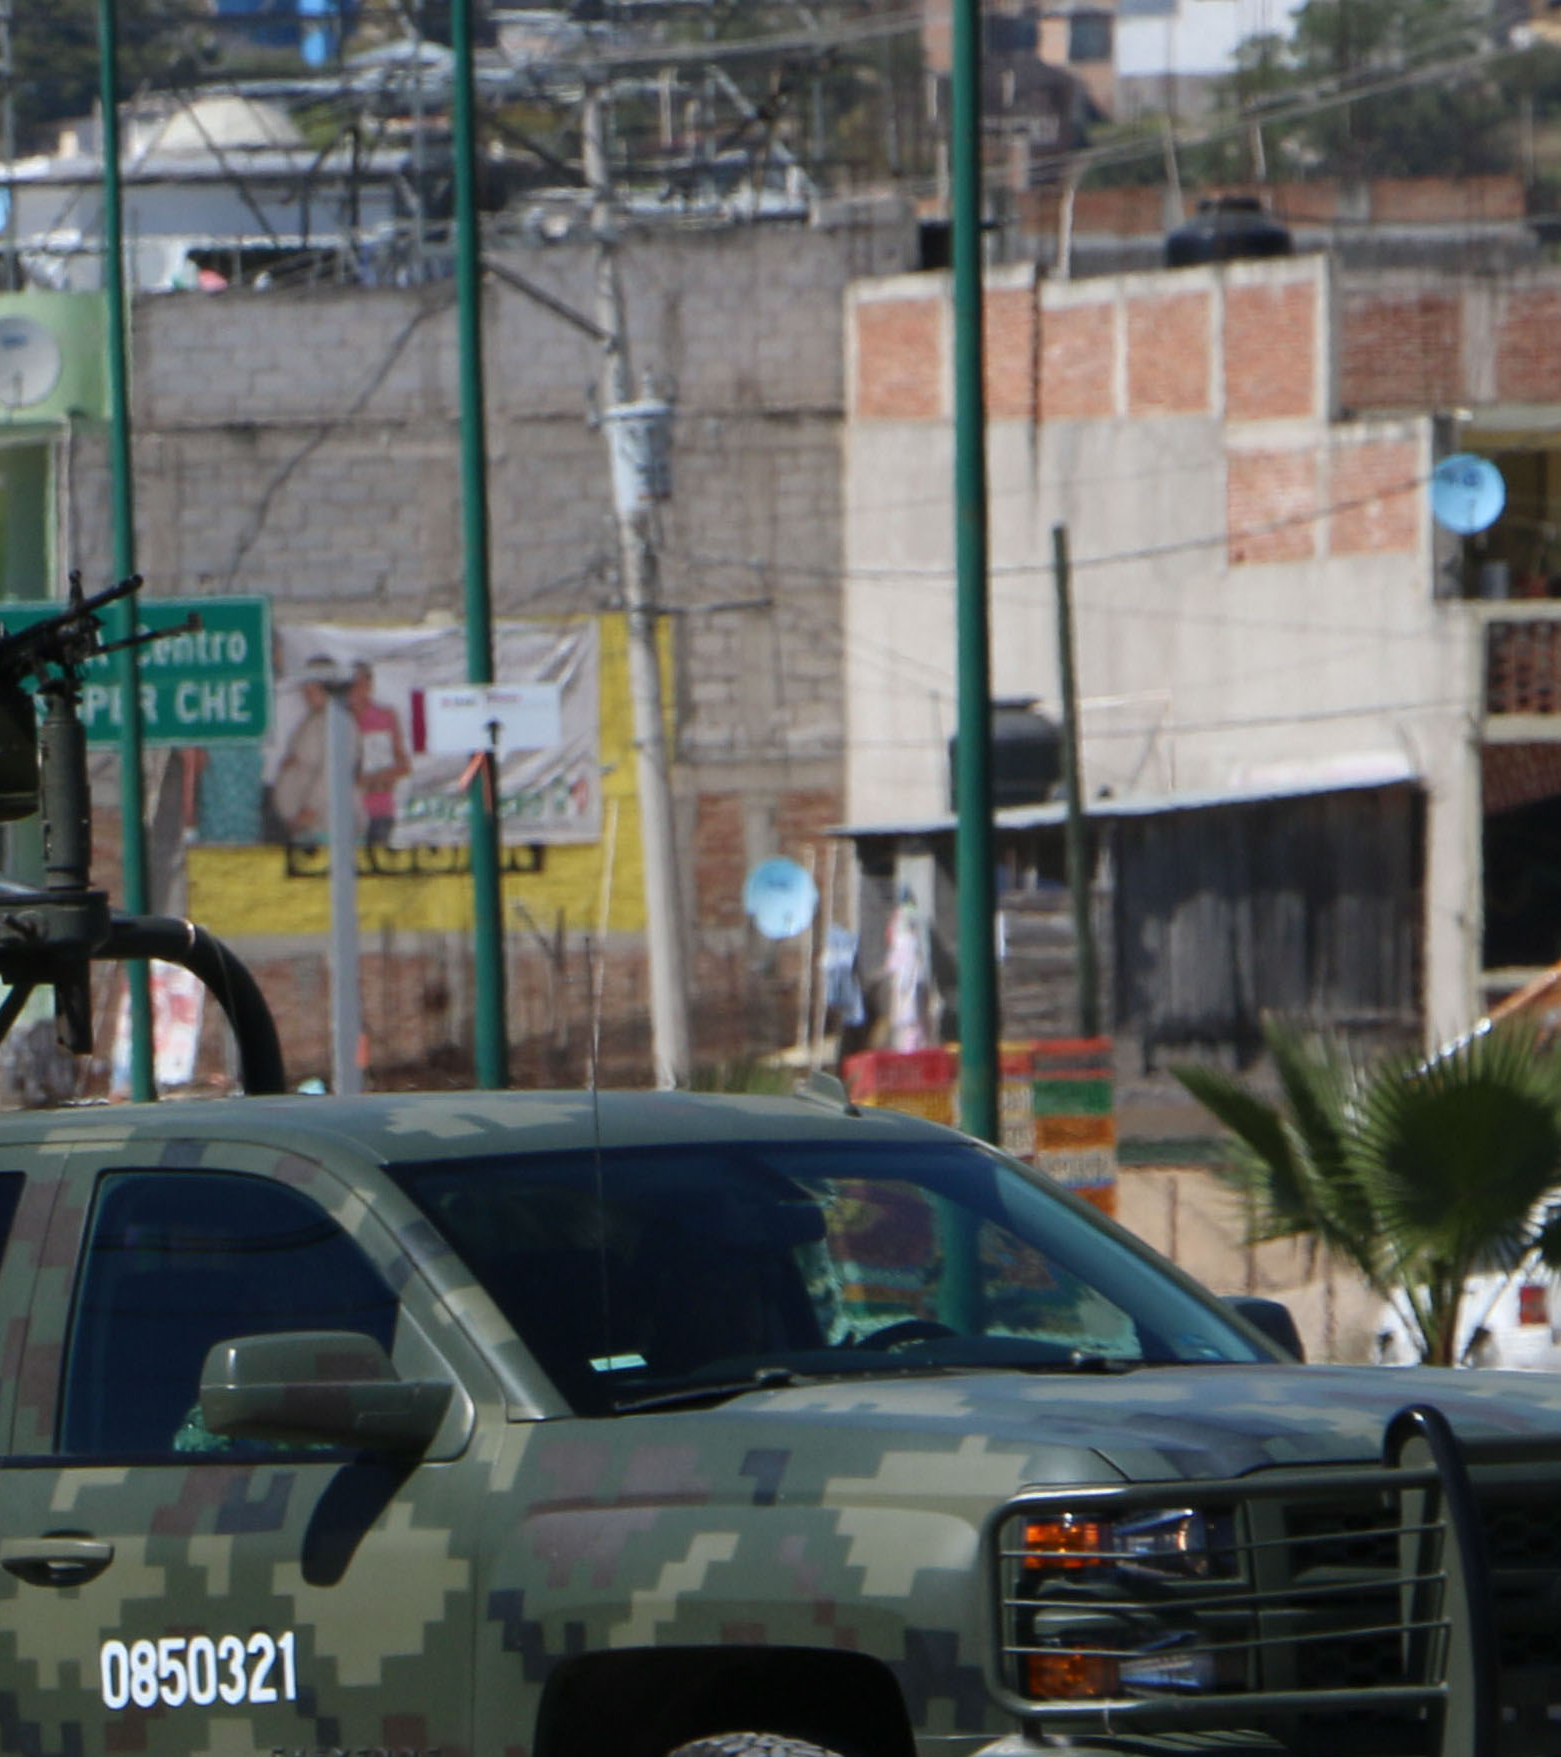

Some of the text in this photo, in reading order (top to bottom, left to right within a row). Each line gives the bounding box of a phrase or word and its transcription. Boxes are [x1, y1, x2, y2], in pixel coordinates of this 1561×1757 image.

[137, 622, 247, 668] Centro
[175, 679, 252, 723] CHE
[100, 1631, 297, 1709] 0850321
